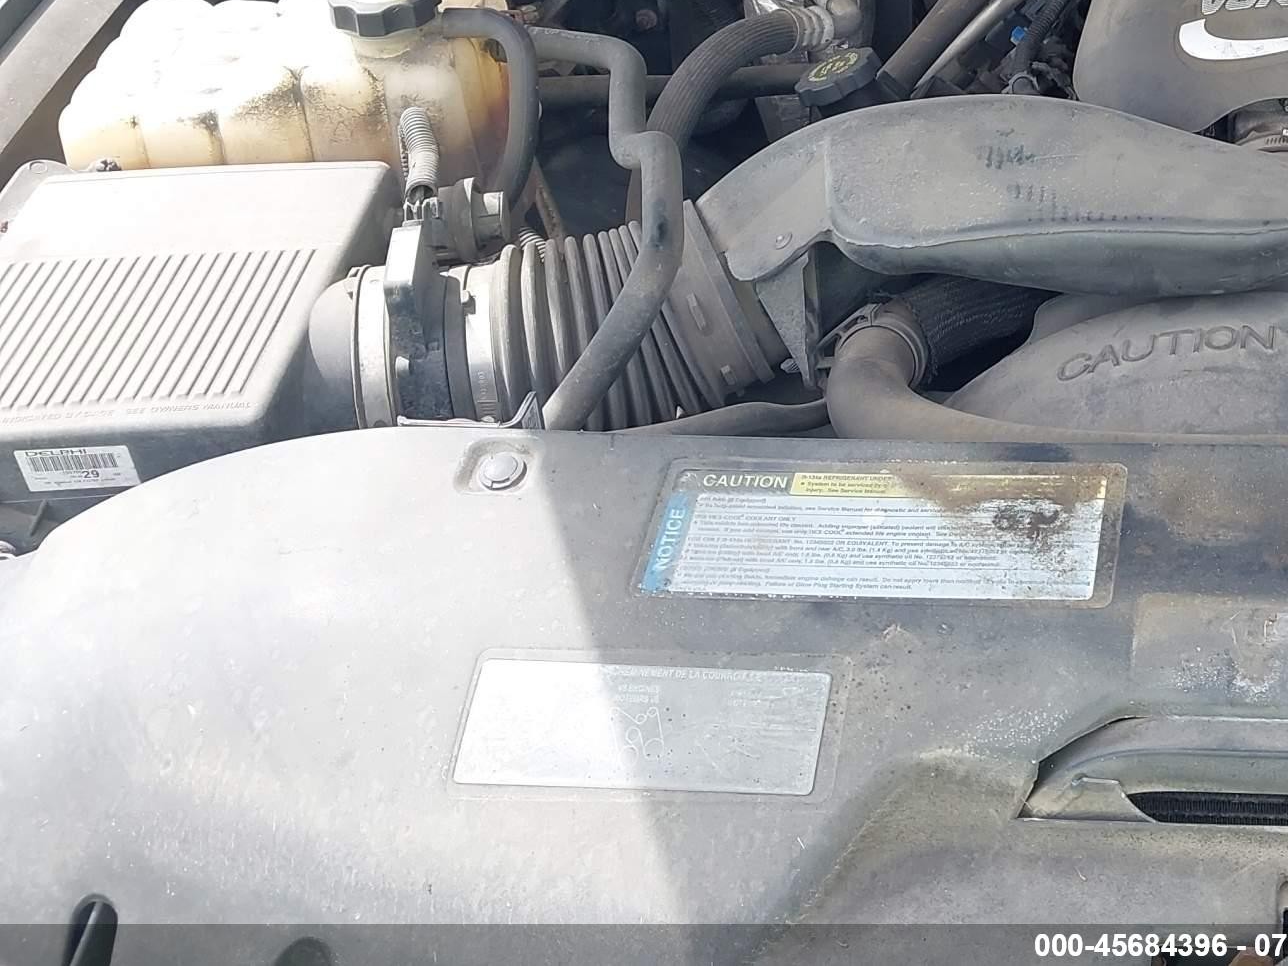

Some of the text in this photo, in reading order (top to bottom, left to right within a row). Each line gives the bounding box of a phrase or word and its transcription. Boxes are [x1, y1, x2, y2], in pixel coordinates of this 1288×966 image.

[1055, 324, 1278, 382] CAUTION
[81, 470, 100, 479] 29
[703, 473, 788, 489] CAUTION
[654, 508, 686, 571] NOTICE
